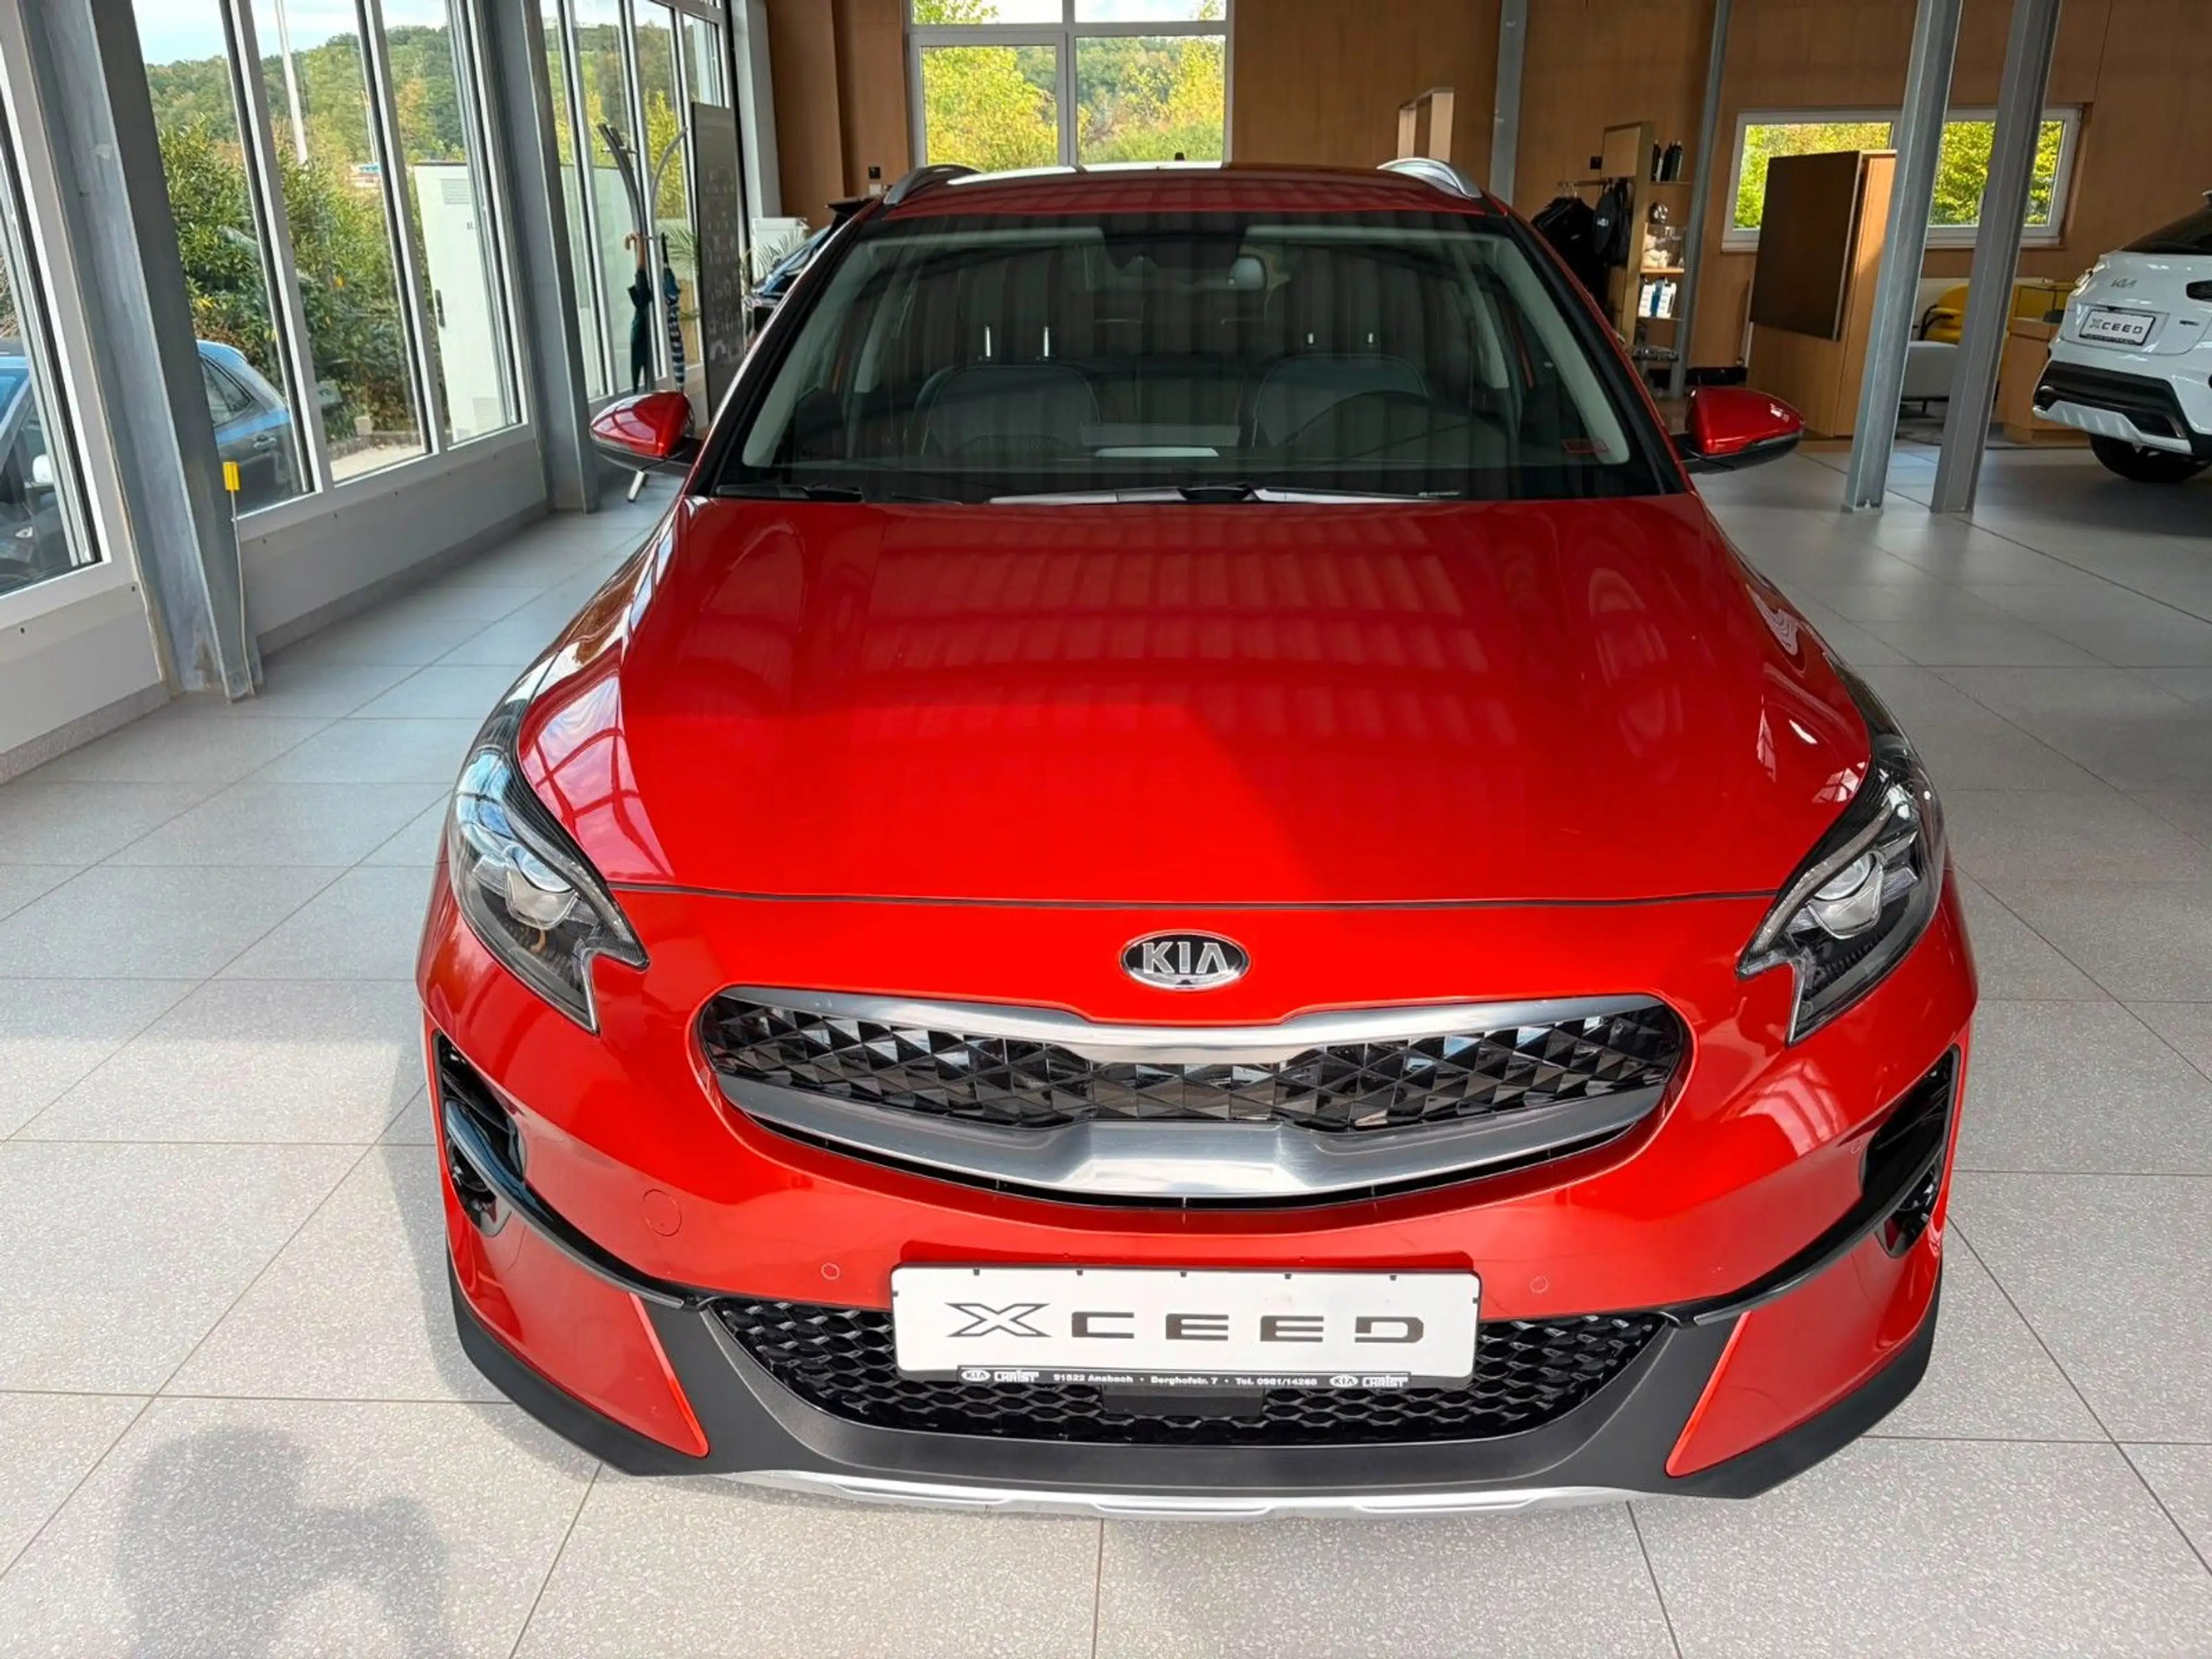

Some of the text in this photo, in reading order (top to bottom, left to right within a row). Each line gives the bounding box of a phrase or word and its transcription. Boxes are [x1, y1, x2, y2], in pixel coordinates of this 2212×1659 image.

[2089, 318, 2143, 335] XCEED
[1142, 941, 1229, 974] KIA
[945, 1303, 1424, 1343] XCEED
[964, 1371, 988, 1380] KIA
